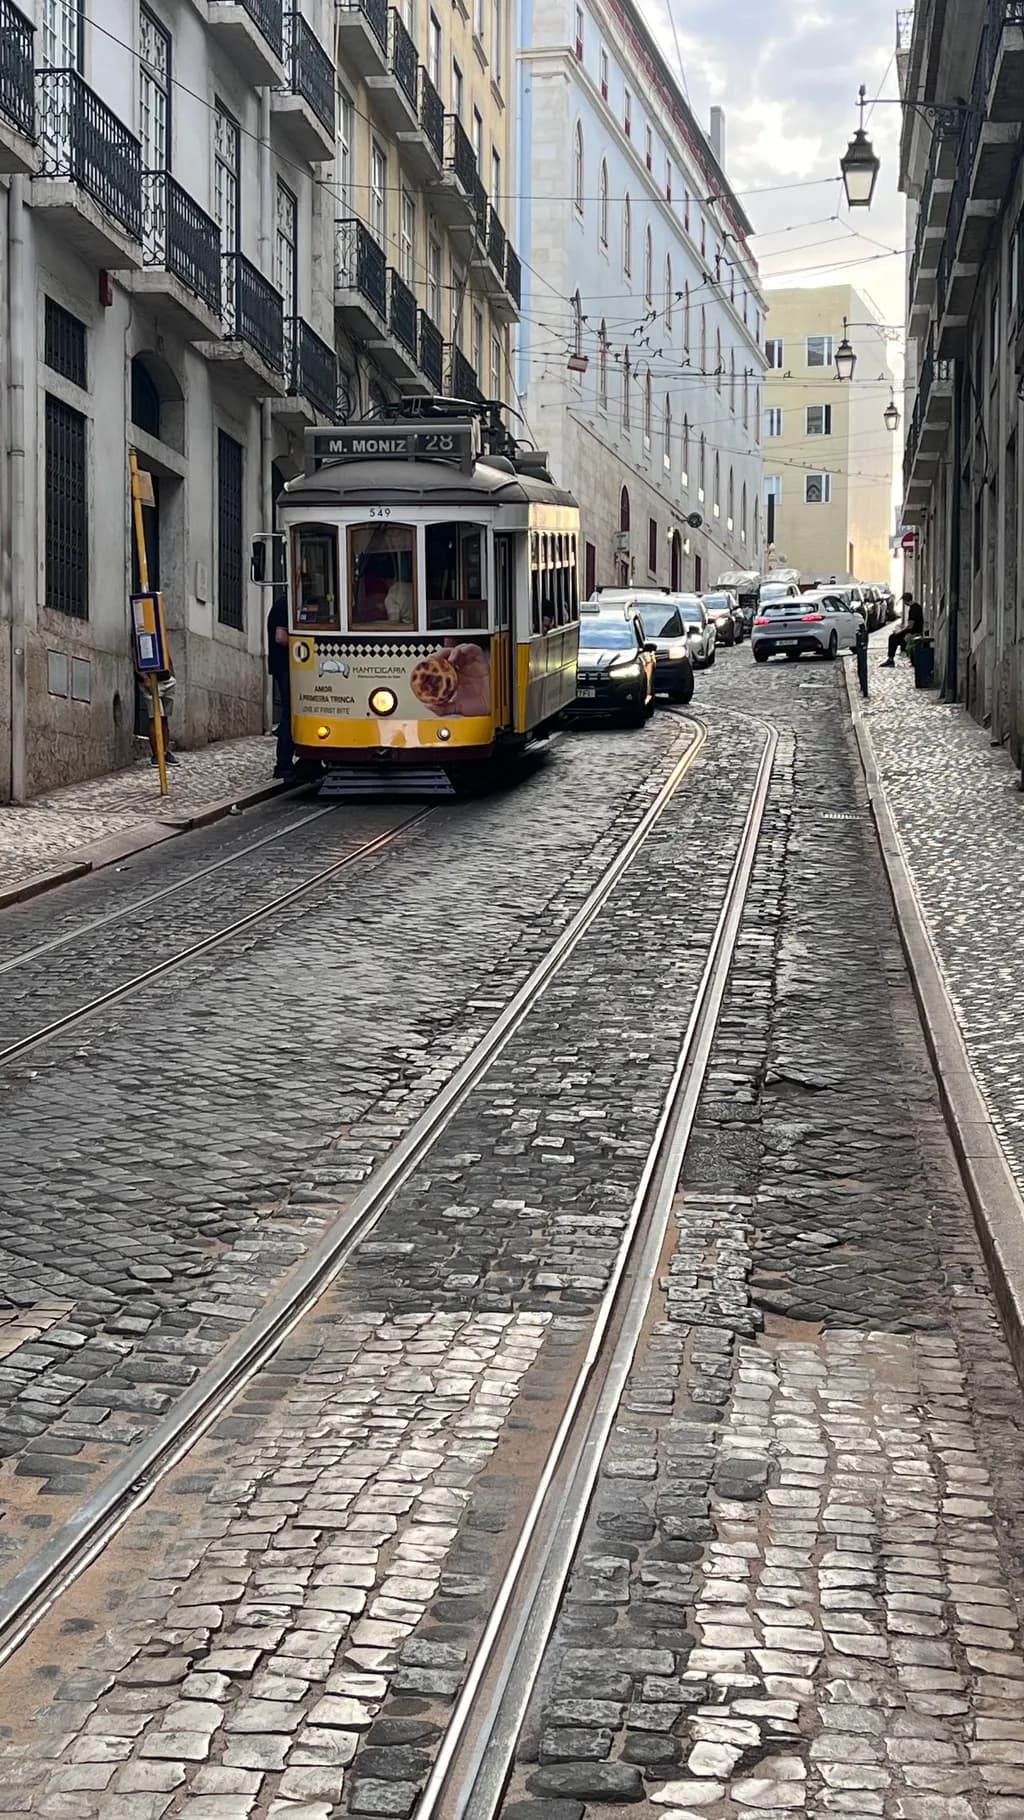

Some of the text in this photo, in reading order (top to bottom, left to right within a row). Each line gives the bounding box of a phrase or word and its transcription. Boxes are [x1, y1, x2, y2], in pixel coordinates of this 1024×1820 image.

[329, 440, 407, 452] M. MONIZ
[425, 435, 454, 450] 28
[369, 508, 391, 517] 549
[314, 685, 333, 693] AMOR
[330, 695, 355, 704] TRINCA
